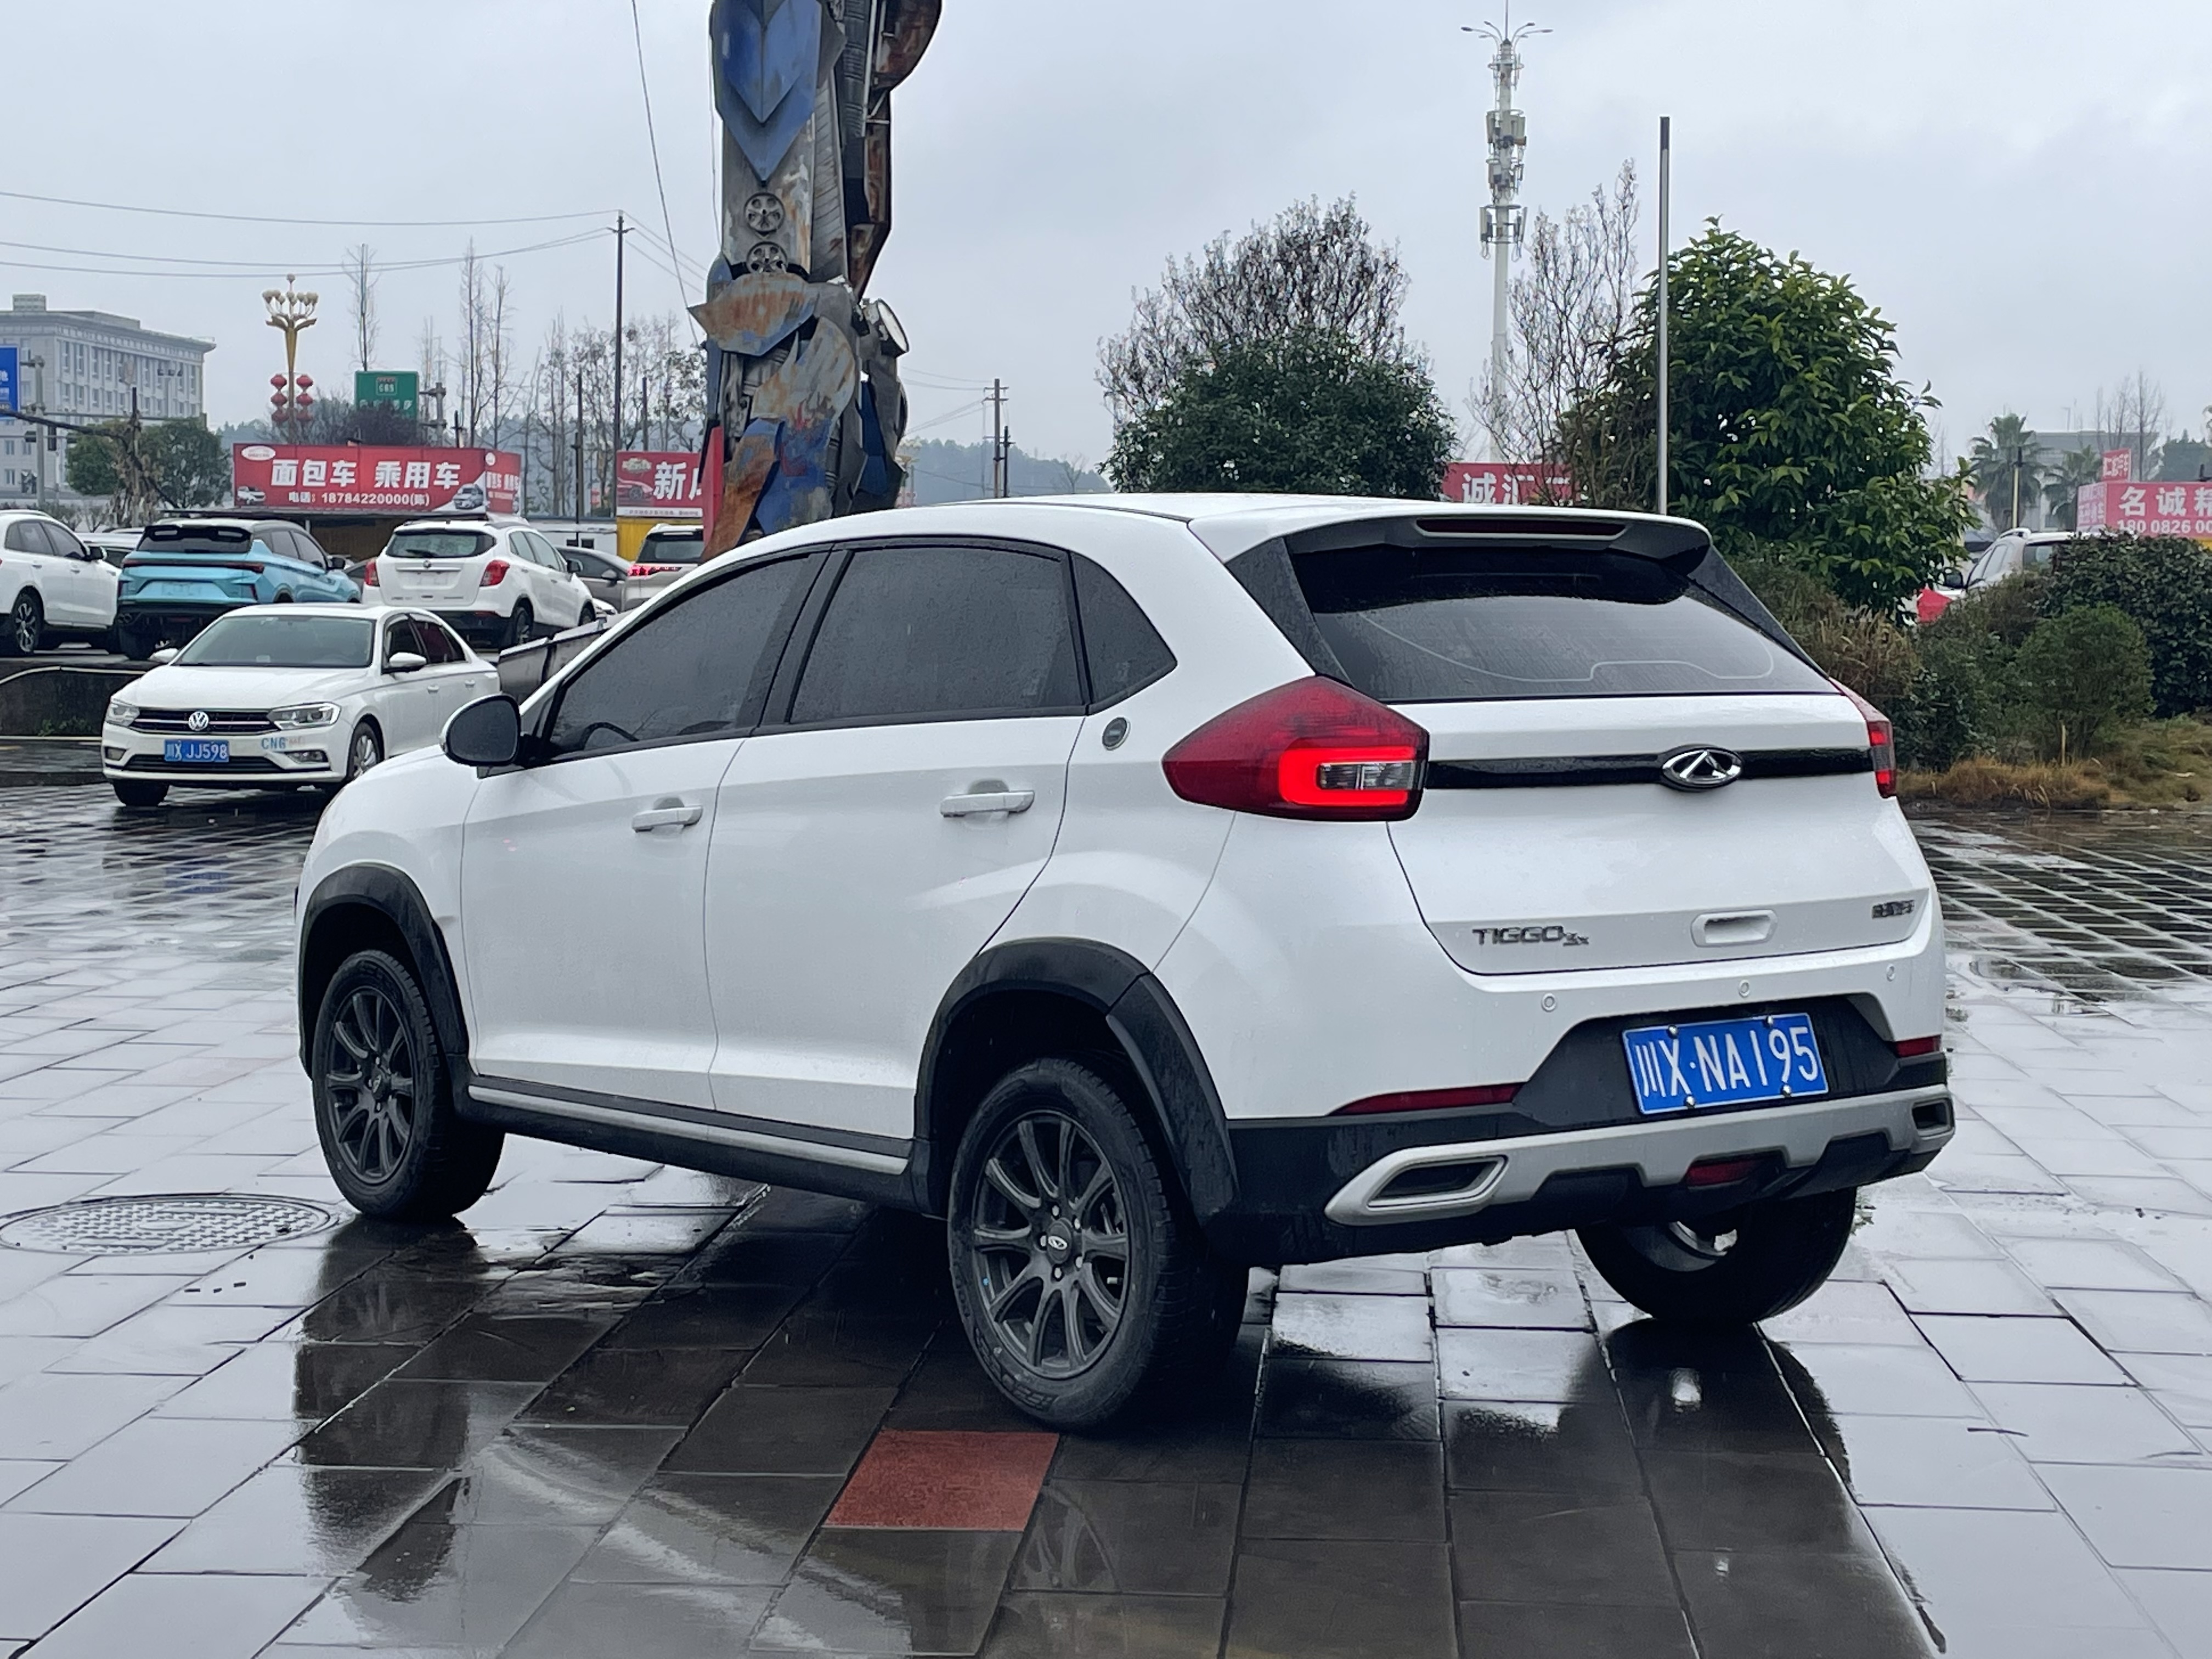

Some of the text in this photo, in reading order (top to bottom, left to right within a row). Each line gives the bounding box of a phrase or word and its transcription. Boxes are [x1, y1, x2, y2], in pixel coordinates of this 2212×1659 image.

[270, 459, 357, 487] 面包车
[374, 461, 461, 490] 乘用车
[2151, 520, 2191, 534] 0826
[261, 737, 286, 749] CNG
